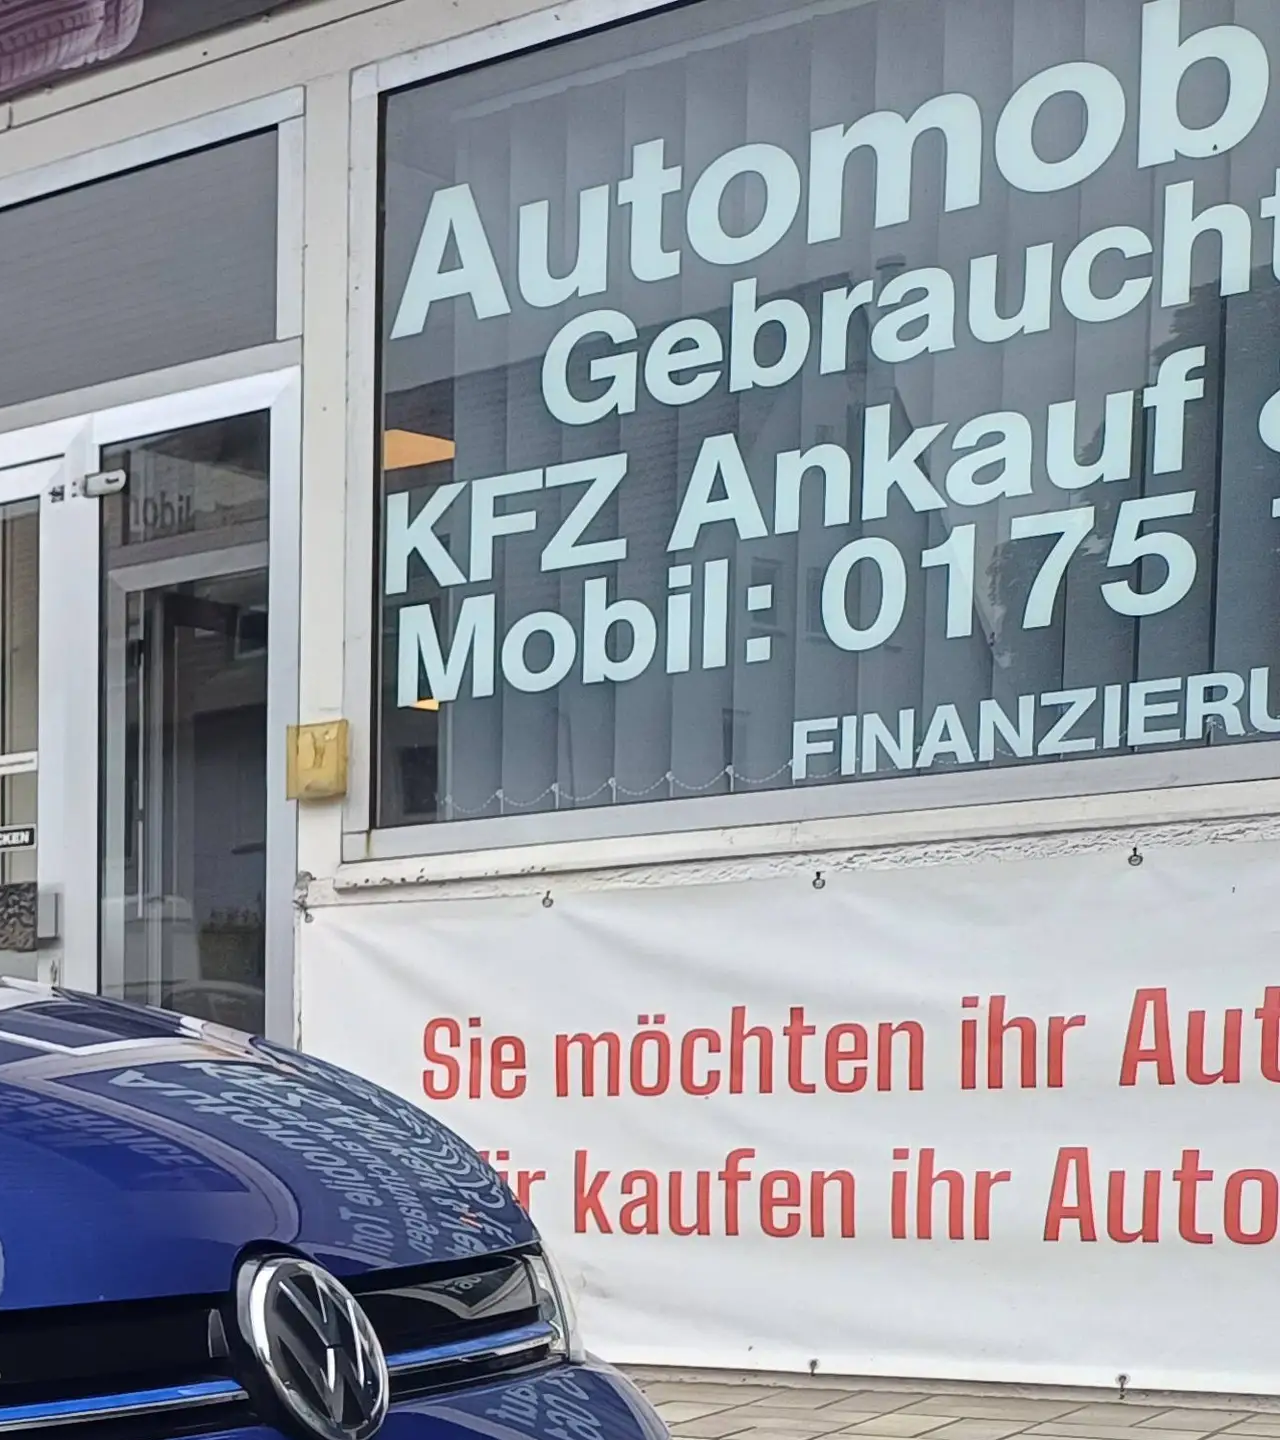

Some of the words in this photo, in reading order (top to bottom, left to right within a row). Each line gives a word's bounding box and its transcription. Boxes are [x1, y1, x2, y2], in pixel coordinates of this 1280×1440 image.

[390, 0, 1270, 339] Automob
[384, 452, 628, 595] KFZ
[667, 346, 1206, 551] Ankauf
[396, 558, 773, 708] Mobil:
[821, 490, 1198, 652] 0175
[422, 1015, 527, 1101] Sie
[555, 1005, 924, 1098] möchten
[961, 993, 1087, 1091] ihr
[574, 1147, 856, 1240] kaufen
[891, 1147, 1011, 1242] ihr
[1043, 1146, 1280, 1245] Auto
